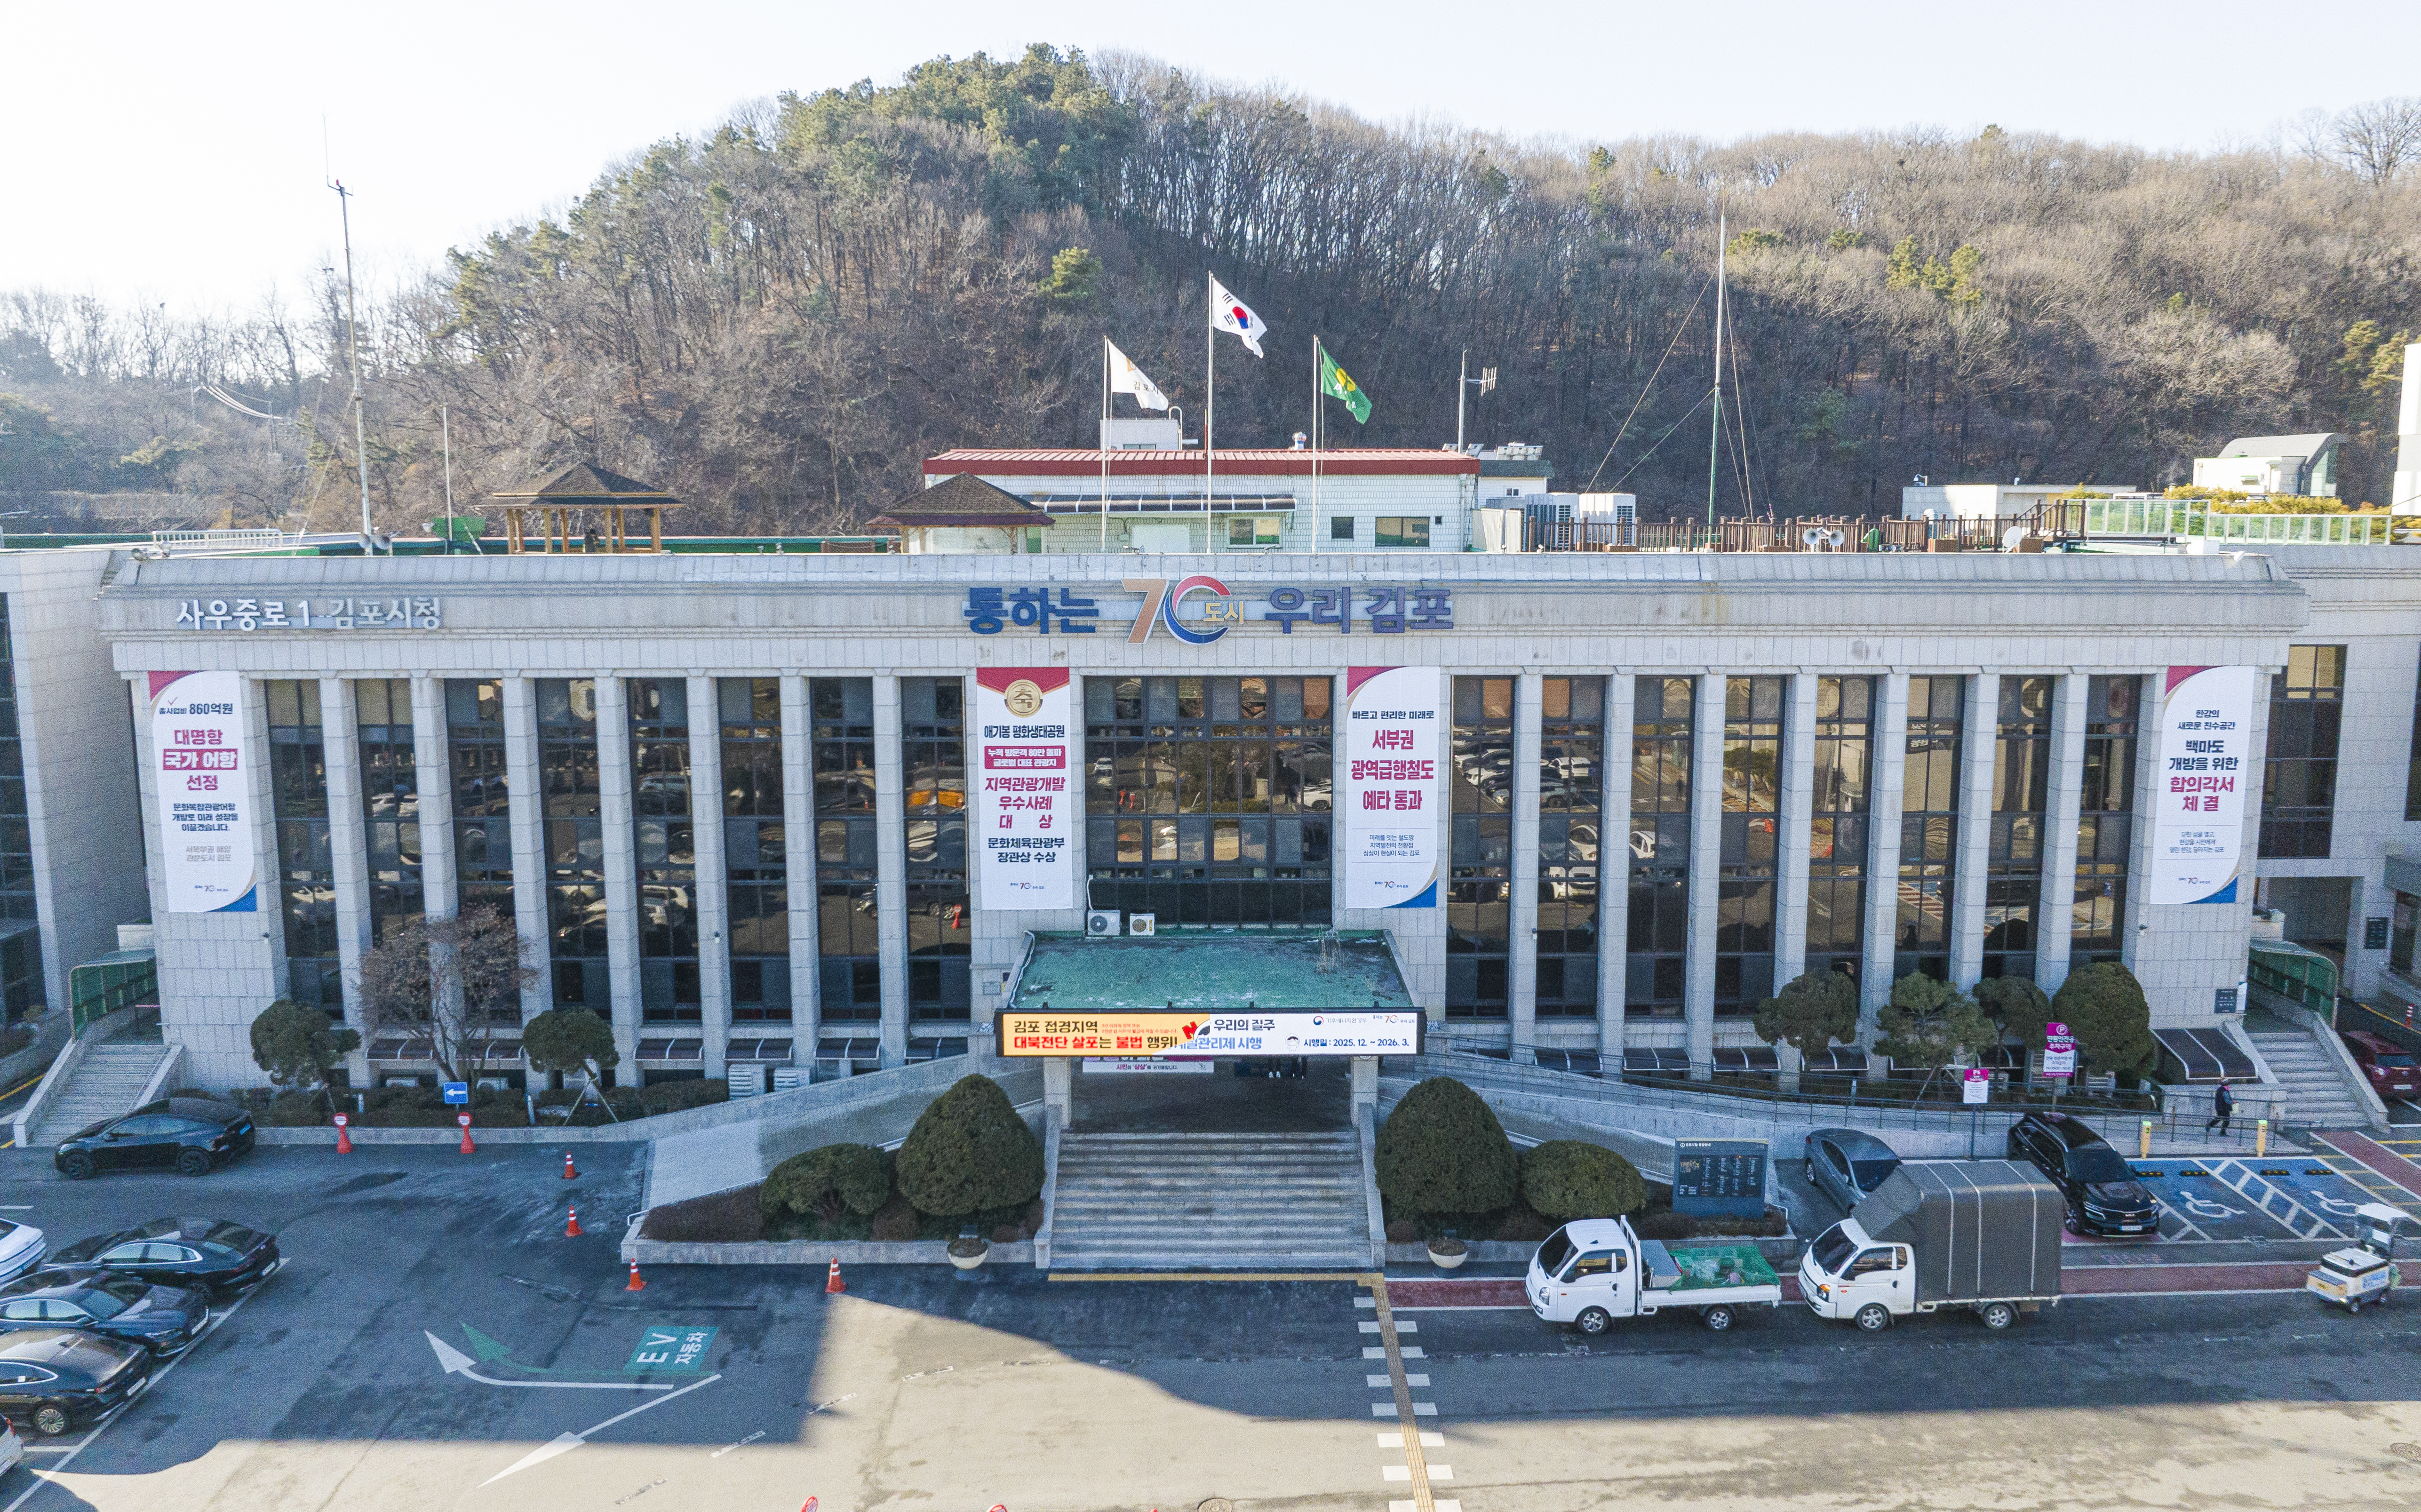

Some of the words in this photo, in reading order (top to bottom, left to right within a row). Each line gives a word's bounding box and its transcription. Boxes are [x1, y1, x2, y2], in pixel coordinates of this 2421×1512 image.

[1133, 381, 1159, 395] 김포시
[176, 598, 290, 631] 사우중로
[298, 601, 311, 626] 1
[331, 597, 441, 630] 김포시청
[964, 587, 1099, 634] 통하는
[1203, 602, 1245, 624] 도시
[1265, 587, 1351, 634] 우리
[1366, 587, 1454, 633] 김포
[1013, 688, 1034, 708] 축
[189, 703, 233, 715] 860억원
[1352, 711, 1378, 719] 빠르고
[1381, 711, 1406, 719] 편리한
[1409, 710, 1434, 719] 미래로
[2195, 709, 2220, 718] 한강의
[984, 725, 1010, 738] 애기봉
[1013, 725, 1065, 738] 평화생태공원
[2177, 721, 2201, 731] 새로운
[2203, 721, 2236, 731] 친수공간
[174, 729, 223, 745] 대명항
[1372, 730, 1414, 750] 서부권
[988, 748, 1003, 757] 누적
[1004, 748, 1027, 757] 방문객
[1028, 748, 1045, 757] 80만
[1046, 748, 1062, 756] 돌파
[2185, 740, 2224, 753] 백마도
[165, 751, 199, 769] 국가
[202, 751, 237, 769] 어항
[1034, 758, 1057, 767] 관광지
[2168, 757, 2208, 771] 개방을
[2212, 757, 2238, 771] 위한
[1351, 760, 1434, 780] 광역급행철도
[187, 775, 218, 791] 선정
[985, 777, 1066, 791] 지역관광개발
[2170, 776, 2235, 793] 합의각서
[999, 796, 1052, 810] 우수사례
[1363, 790, 1391, 810] 예타
[1394, 790, 1423, 810] 통과
[988, 837, 1065, 849] 문화체육관광부
[997, 852, 1031, 863] 장관상
[1034, 851, 1056, 863] 수상
[1014, 1020, 1040, 1033] 김포
[1044, 1020, 1098, 1033] 접경지역
[1214, 1019, 1249, 1031] 우리의
[1251, 1019, 1275, 1031] 질주
[1014, 1036, 1068, 1049] 대북전단
[1072, 1036, 1112, 1049] 살포는
[1116, 1036, 1143, 1049] 불법
[1147, 1036, 1178, 1049] 행위!
[1238, 1037, 1262, 1049] 시행
[636, 1333, 677, 1363] EV
[674, 1332, 709, 1364] 자동차
